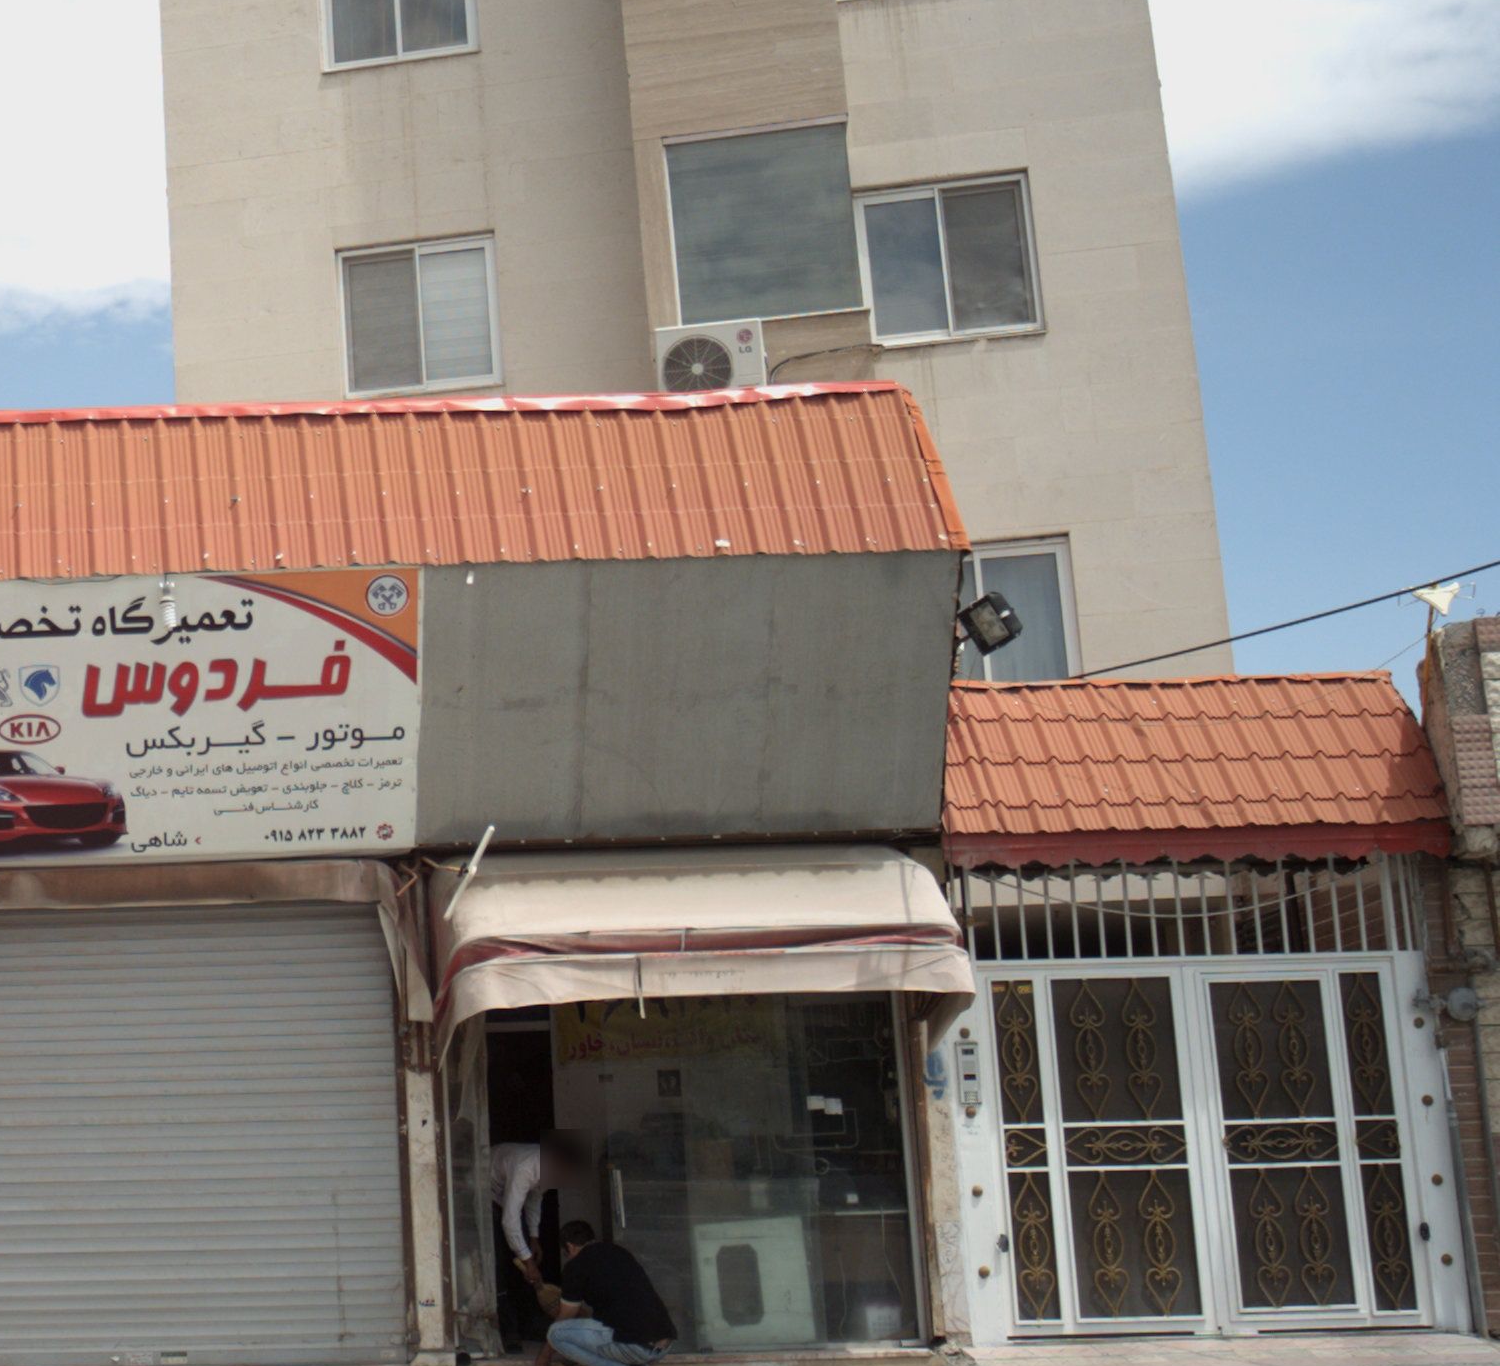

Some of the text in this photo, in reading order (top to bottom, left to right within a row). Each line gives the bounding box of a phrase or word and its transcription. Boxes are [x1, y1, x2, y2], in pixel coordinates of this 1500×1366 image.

[91, 596, 254, 645] تعمیرگاه
[82, 639, 351, 717] فردوس
[10, 721, 50, 738] KIA
[305, 724, 405, 751] موتور
[126, 720, 265, 758] گیربکس
[129, 756, 403, 779] تعمیرات تخصصی انواع اتومبیل های ایرانی و خارجی
[171, 786, 194, 798] تایم
[196, 785, 227, 795] تسمه
[229, 783, 268, 797] تعویض
[282, 781, 327, 795] جلوبندی
[341, 779, 364, 795] کلاچ
[377, 778, 403, 791] ترمز
[213, 799, 319, 816] کارشناس فنی
[130, 831, 188, 853] شاهی
[264, 828, 293, 842] ۰۹۱۵
